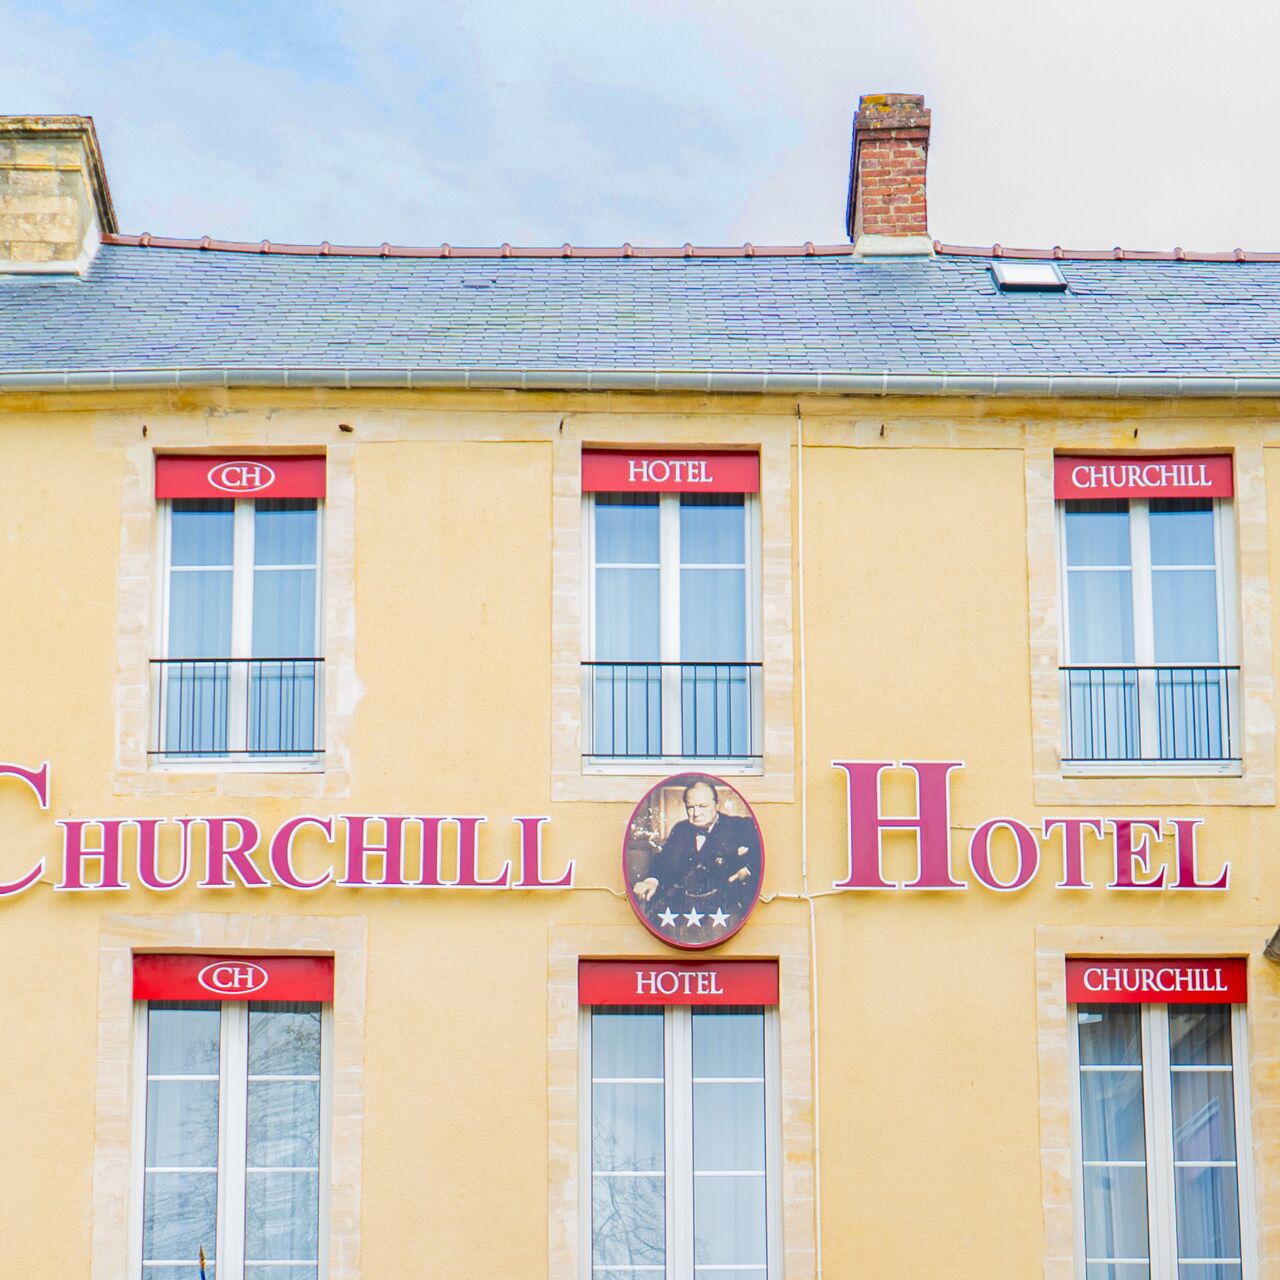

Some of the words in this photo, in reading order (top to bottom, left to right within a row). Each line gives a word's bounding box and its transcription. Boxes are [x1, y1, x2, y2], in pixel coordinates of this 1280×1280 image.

[221, 466, 262, 487] CH
[628, 460, 713, 482] HOTEL
[1071, 464, 1213, 488] CHURCHILL
[830, 760, 1232, 892] HOTEL
[212, 967, 255, 988] CH
[636, 971, 723, 995] HOTEL
[1083, 967, 1228, 992] CHURCHILL
